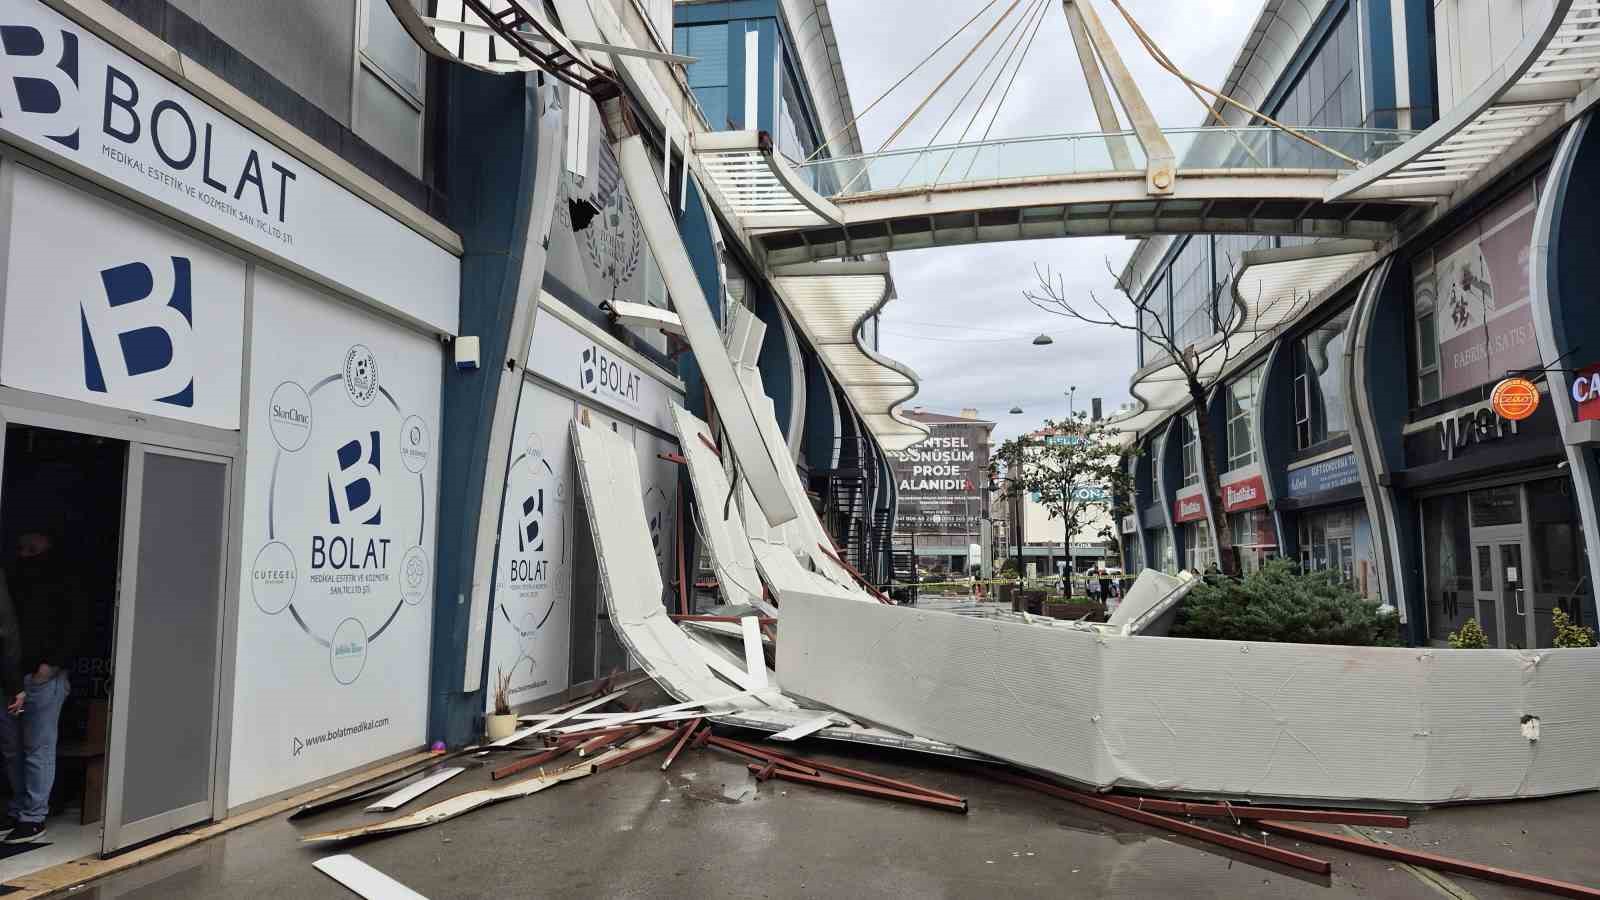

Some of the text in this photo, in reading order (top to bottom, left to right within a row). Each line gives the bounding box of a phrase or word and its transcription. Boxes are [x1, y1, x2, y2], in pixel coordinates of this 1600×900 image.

[102, 64, 297, 223] BOLAT
[185, 185, 197, 199] VE
[600, 355, 641, 403] BOLAT
[913, 437, 969, 448] NTSEL
[912, 465, 960, 476] PROJE
[311, 535, 391, 570] BOLAT
[510, 560, 548, 582] BOLAT
[305, 717, 390, 748] www.bolatmedikal.com
